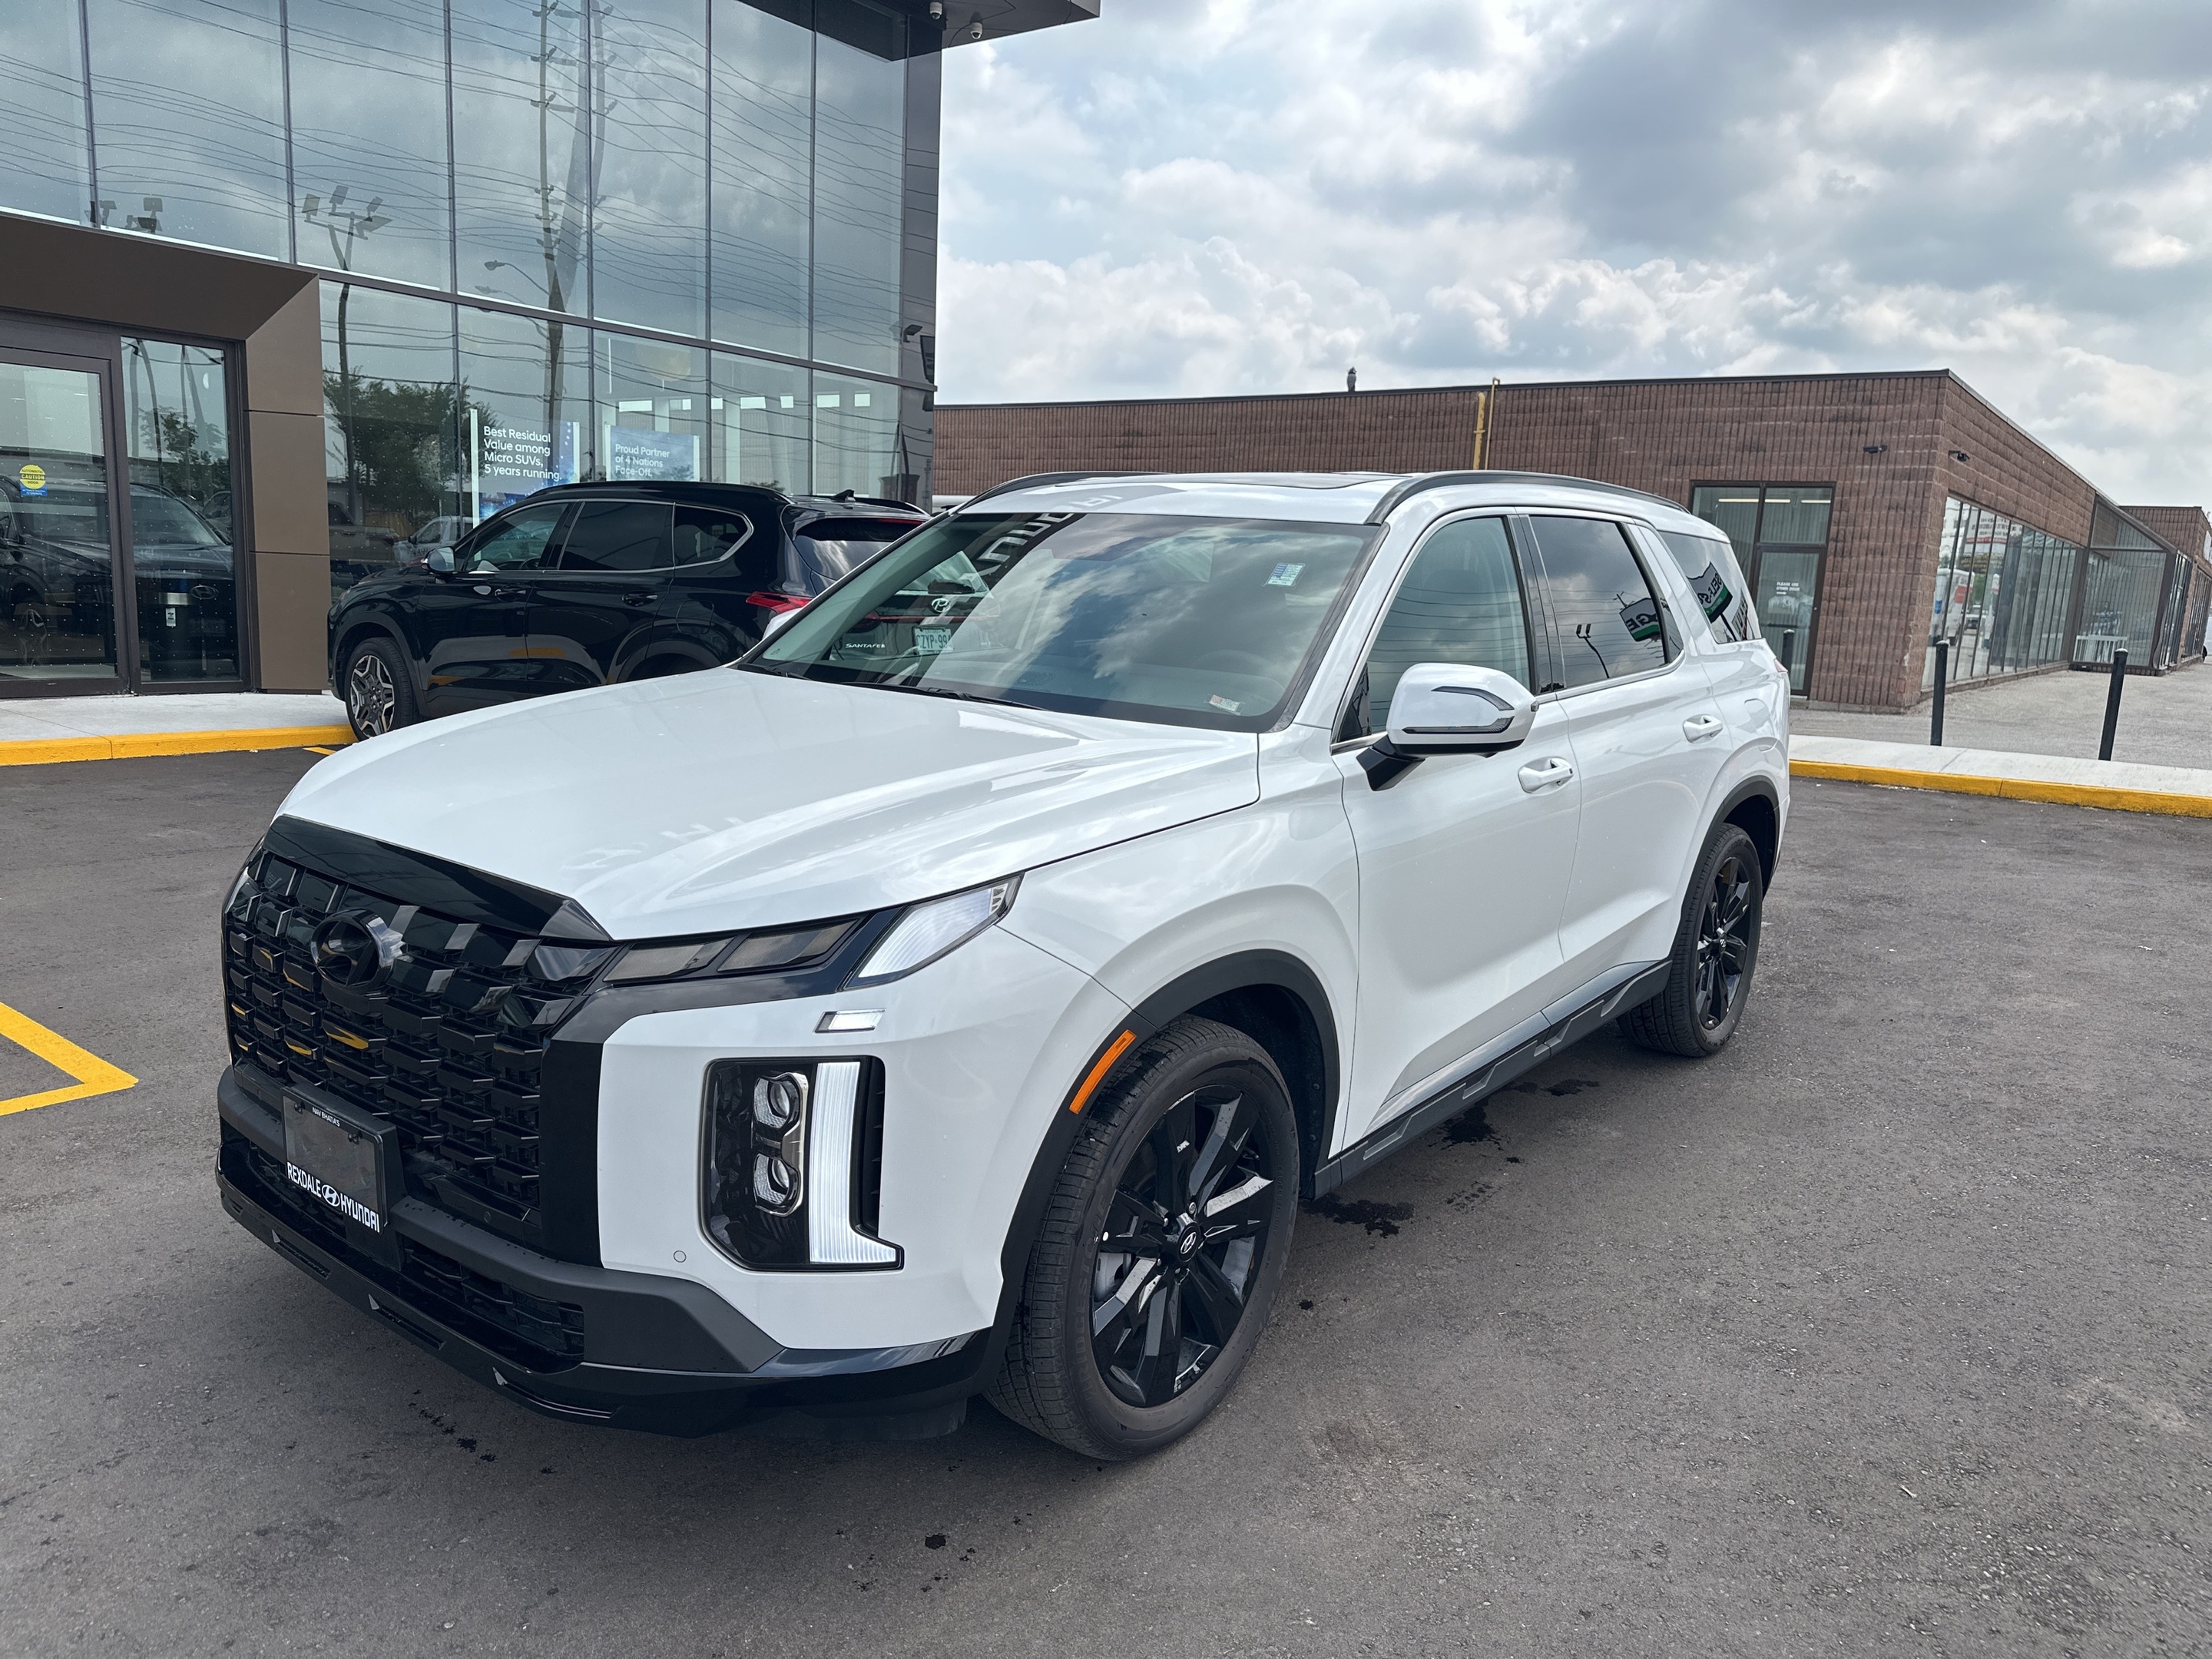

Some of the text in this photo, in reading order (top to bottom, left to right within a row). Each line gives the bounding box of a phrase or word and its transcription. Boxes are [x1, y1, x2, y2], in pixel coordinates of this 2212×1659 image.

[484, 426, 551, 442] Best Residual
[484, 439, 551, 456] Value among
[615, 443, 670, 458] Proud Partner
[484, 451, 544, 468] Micro SUVs,
[615, 455, 664, 468] of 4 Nations
[484, 464, 562, 482] 5 years running.
[615, 465, 653, 477] Face-Off.
[312, 1106, 322, 1117] NAV
[286, 1161, 380, 1233] REXDALE HYUNDAI
